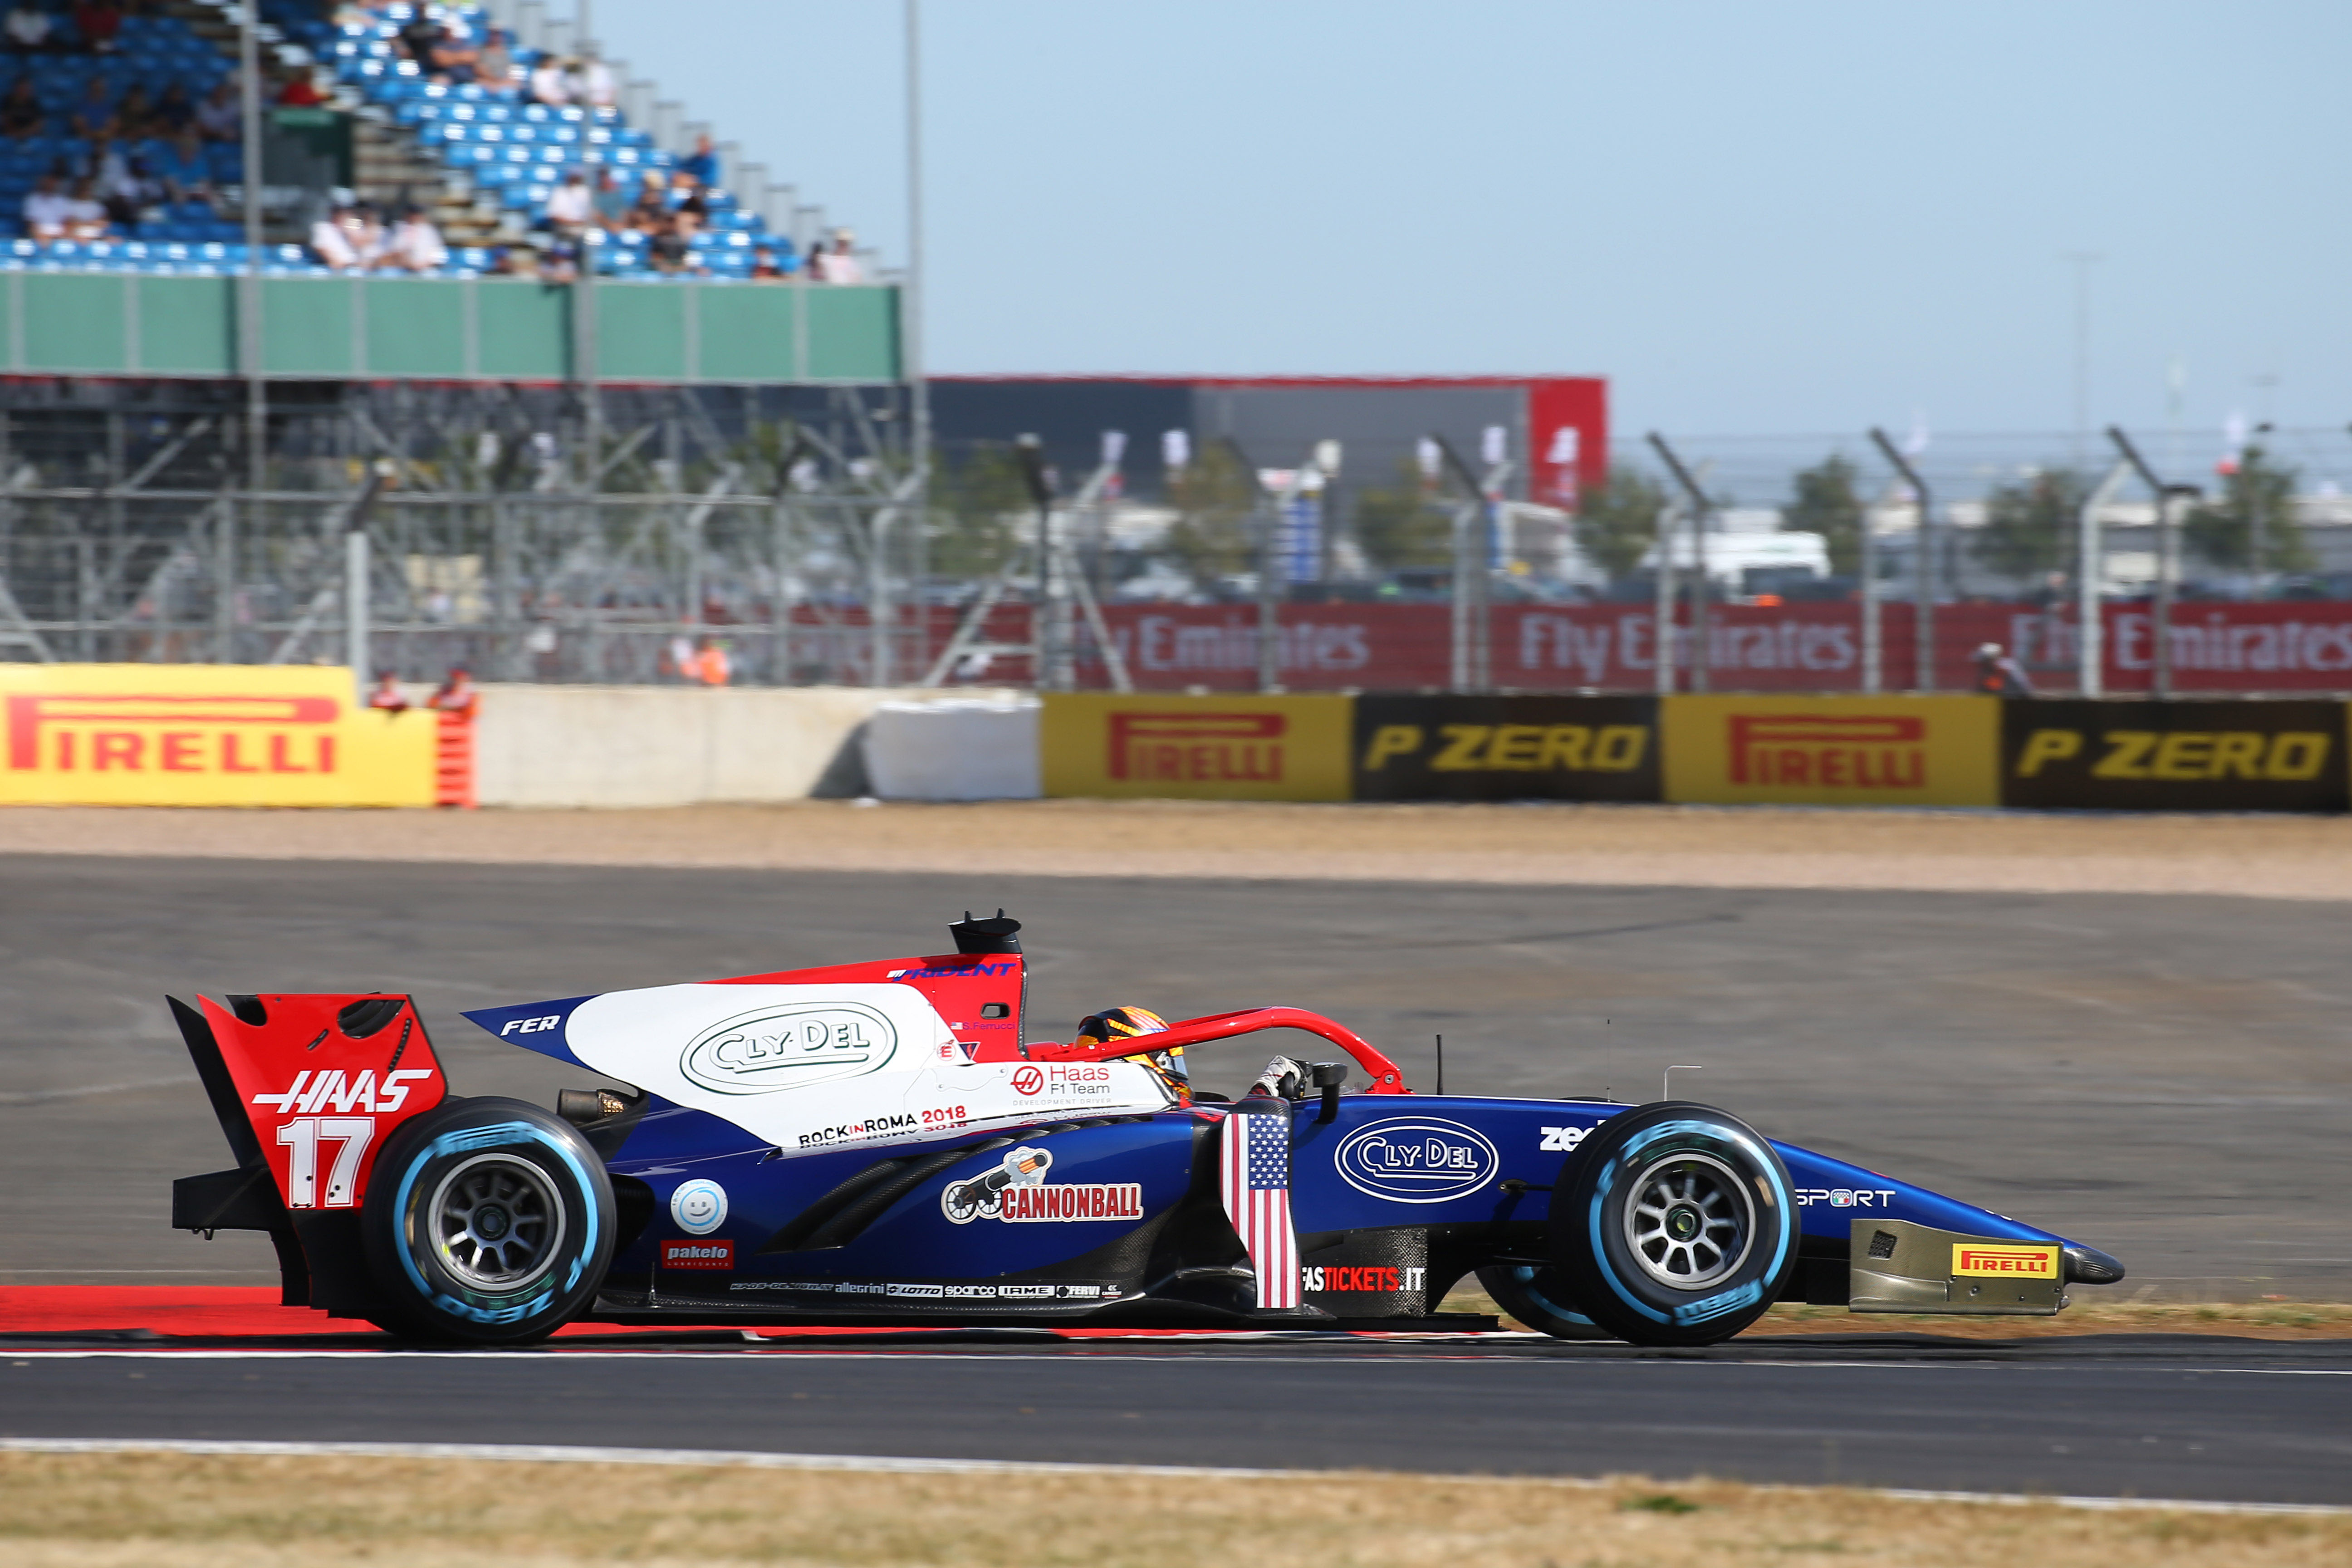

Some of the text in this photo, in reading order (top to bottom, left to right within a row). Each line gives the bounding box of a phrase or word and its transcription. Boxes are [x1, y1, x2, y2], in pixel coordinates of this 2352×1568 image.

[1519, 612, 1611, 682] Fly
[6, 695, 339, 773] PIRELLI
[1106, 710, 1289, 781] PIRELLI
[1364, 724, 1649, 772] P ZERO
[1726, 713, 1926, 788] PIRELLI
[2015, 730, 2331, 780] P ZERO
[887, 963, 1017, 982] TRIDENT
[500, 1015, 561, 1036] FER
[1050, 1065, 1110, 1081] Haas
[251, 1069, 433, 1114] HAAS
[1051, 1083, 1110, 1094] F1 Team
[921, 1105, 966, 1123] 2018
[276, 1116, 375, 1208] 17
[1002, 1186, 1140, 1218] CANNONBALL
[667, 1246, 728, 1259] pakelo
[1961, 1250, 2048, 1273] PIRELLI
[901, 1287, 941, 1295] LOTTO
[945, 1285, 997, 1298] sparco
[1069, 1285, 1100, 1295] FERVI
